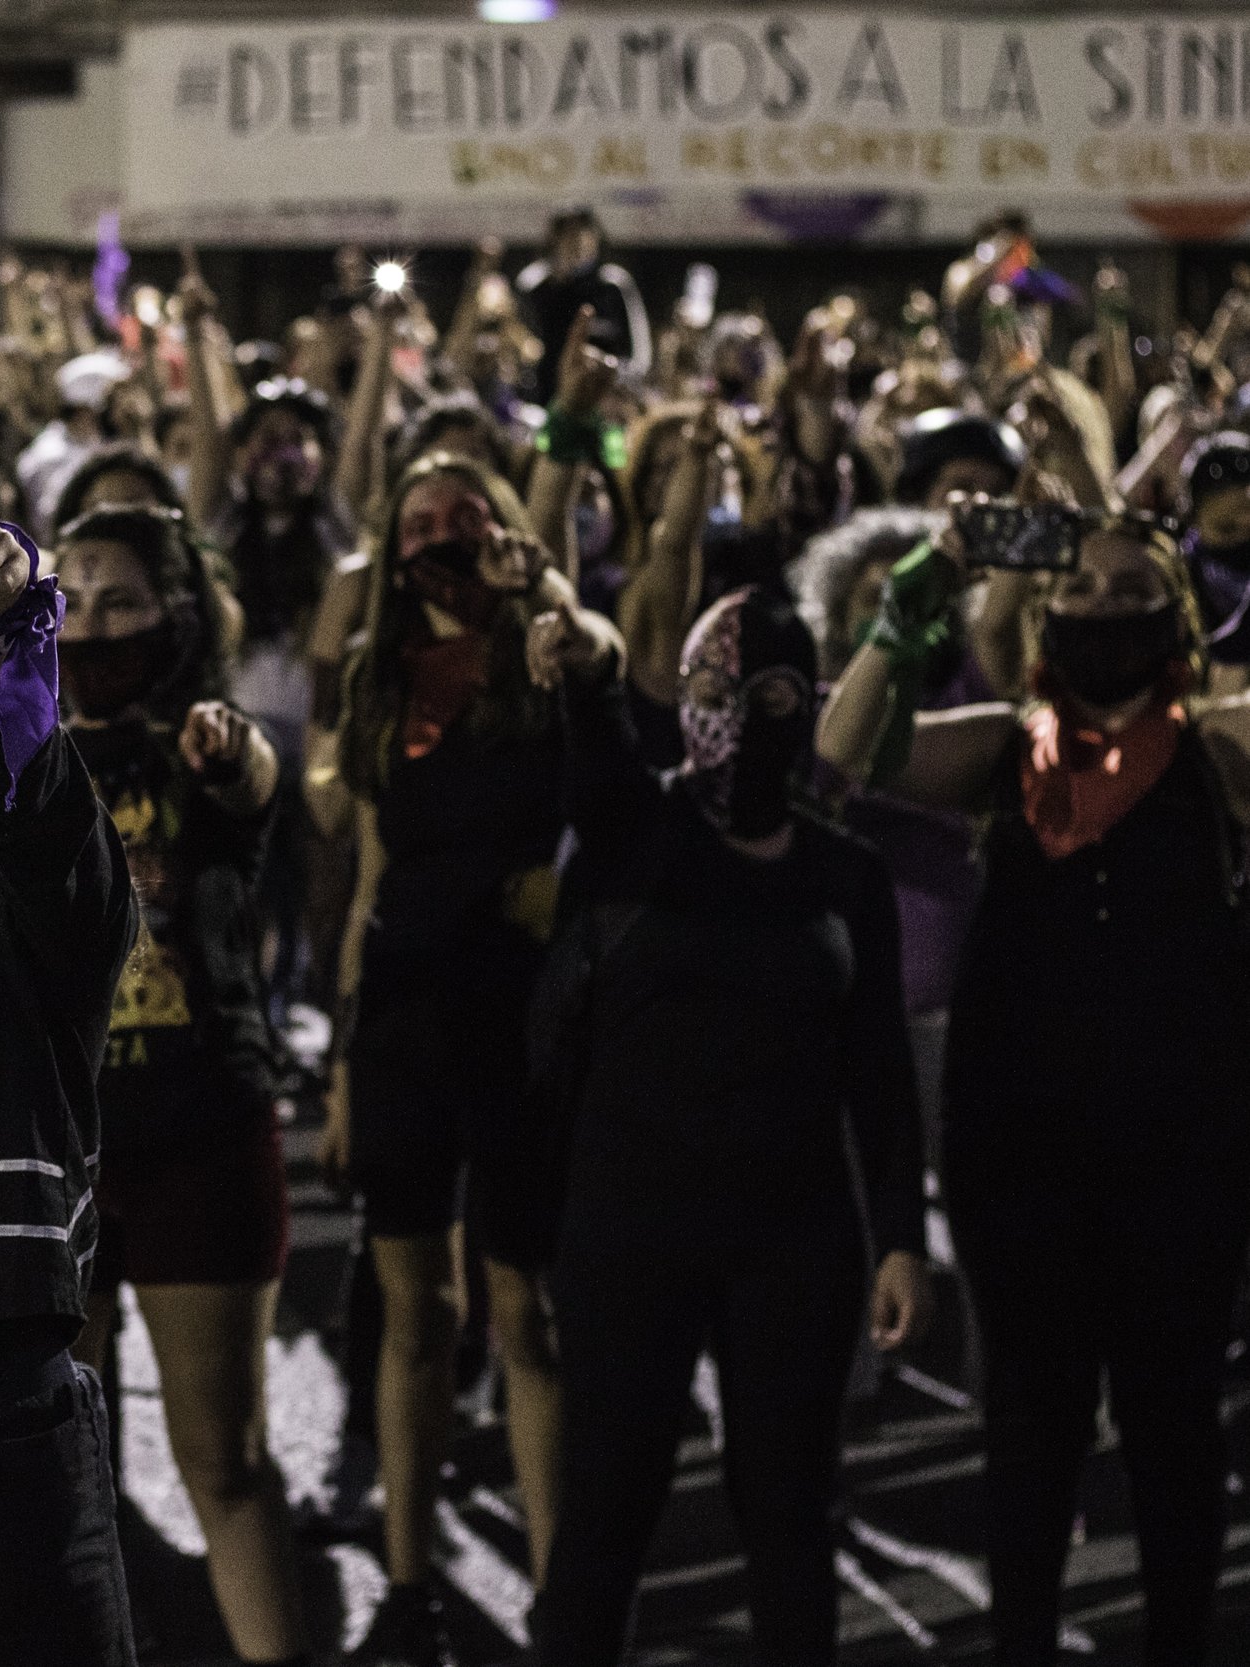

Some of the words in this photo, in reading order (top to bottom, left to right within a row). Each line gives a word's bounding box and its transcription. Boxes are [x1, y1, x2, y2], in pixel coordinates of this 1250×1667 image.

[176, 16, 810, 135] #DEFENDAMOS
[835, 16, 912, 116] A
[938, 27, 1043, 128] LA
